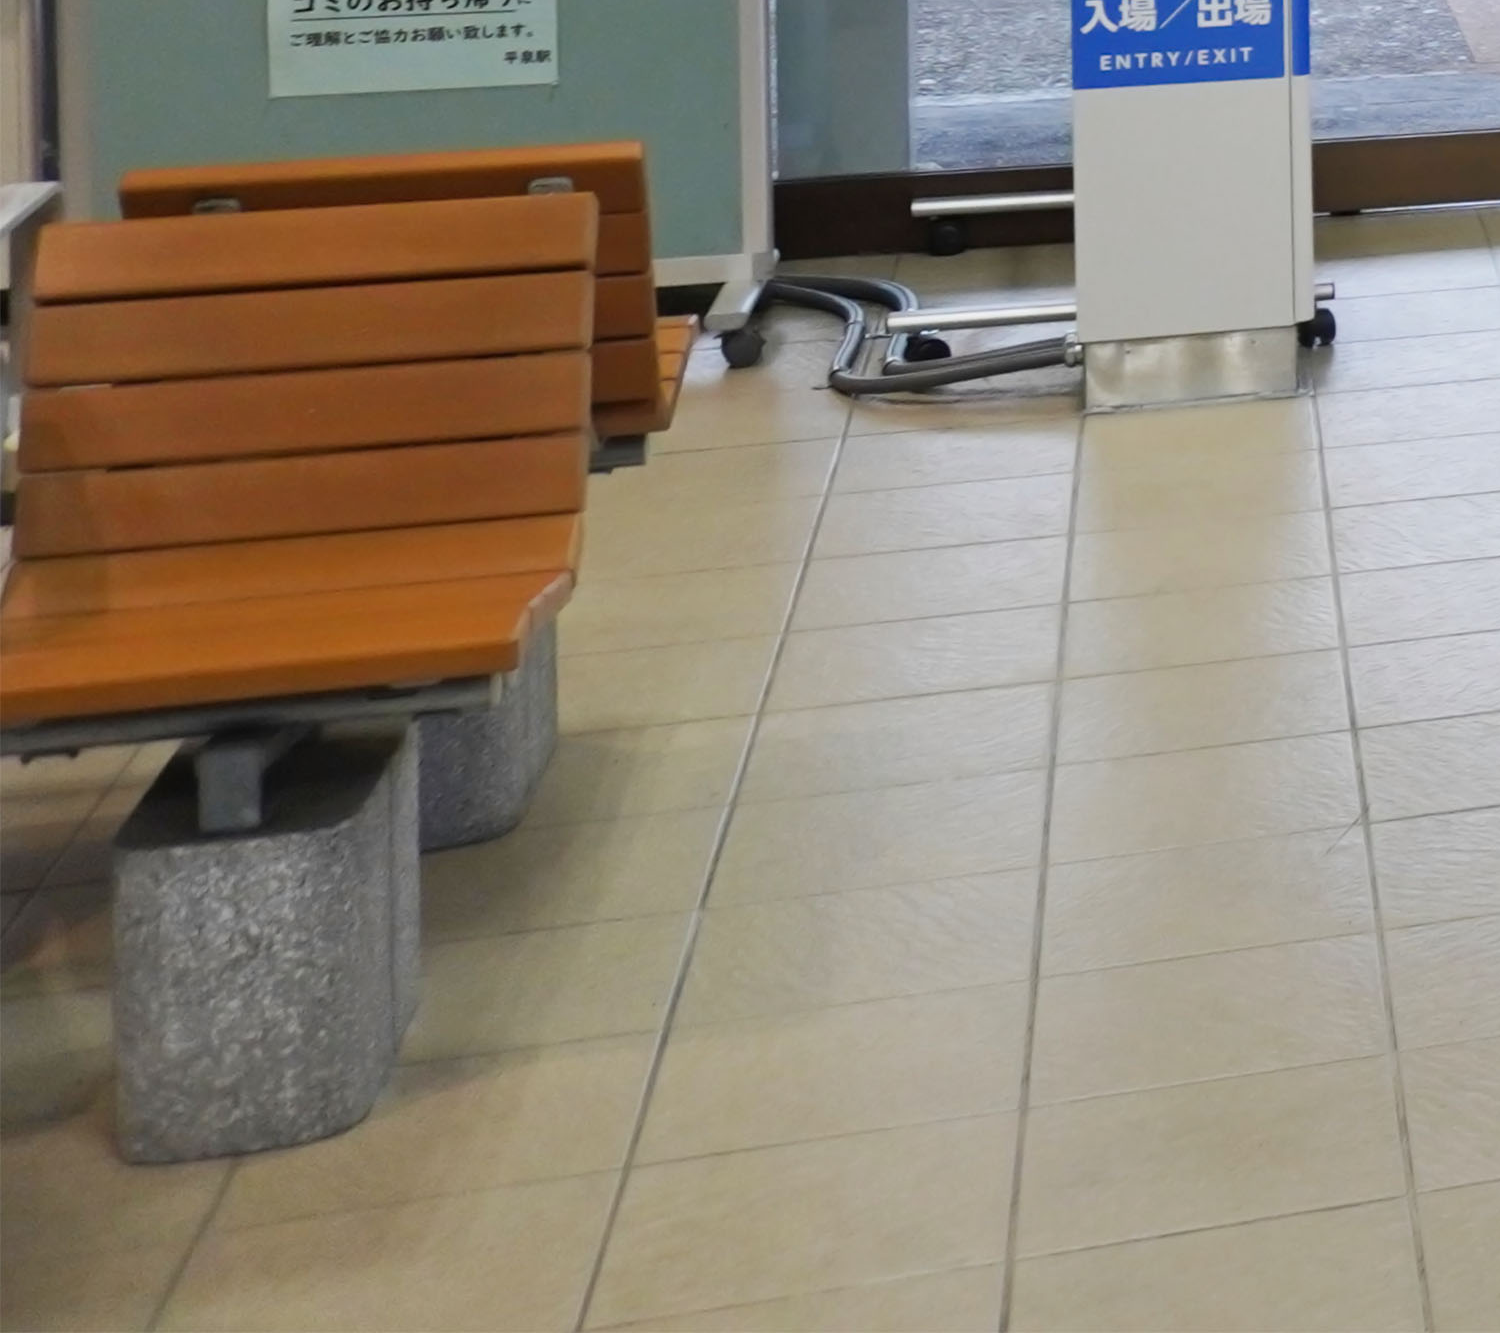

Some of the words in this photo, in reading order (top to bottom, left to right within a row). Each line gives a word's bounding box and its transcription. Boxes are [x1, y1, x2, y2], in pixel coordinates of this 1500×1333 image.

[290, 23, 534, 47] ご理解とご協力お願い致します。
[503, 50, 552, 64] 平泉駅
[1100, 47, 1253, 71] ENTRY/EXIT
